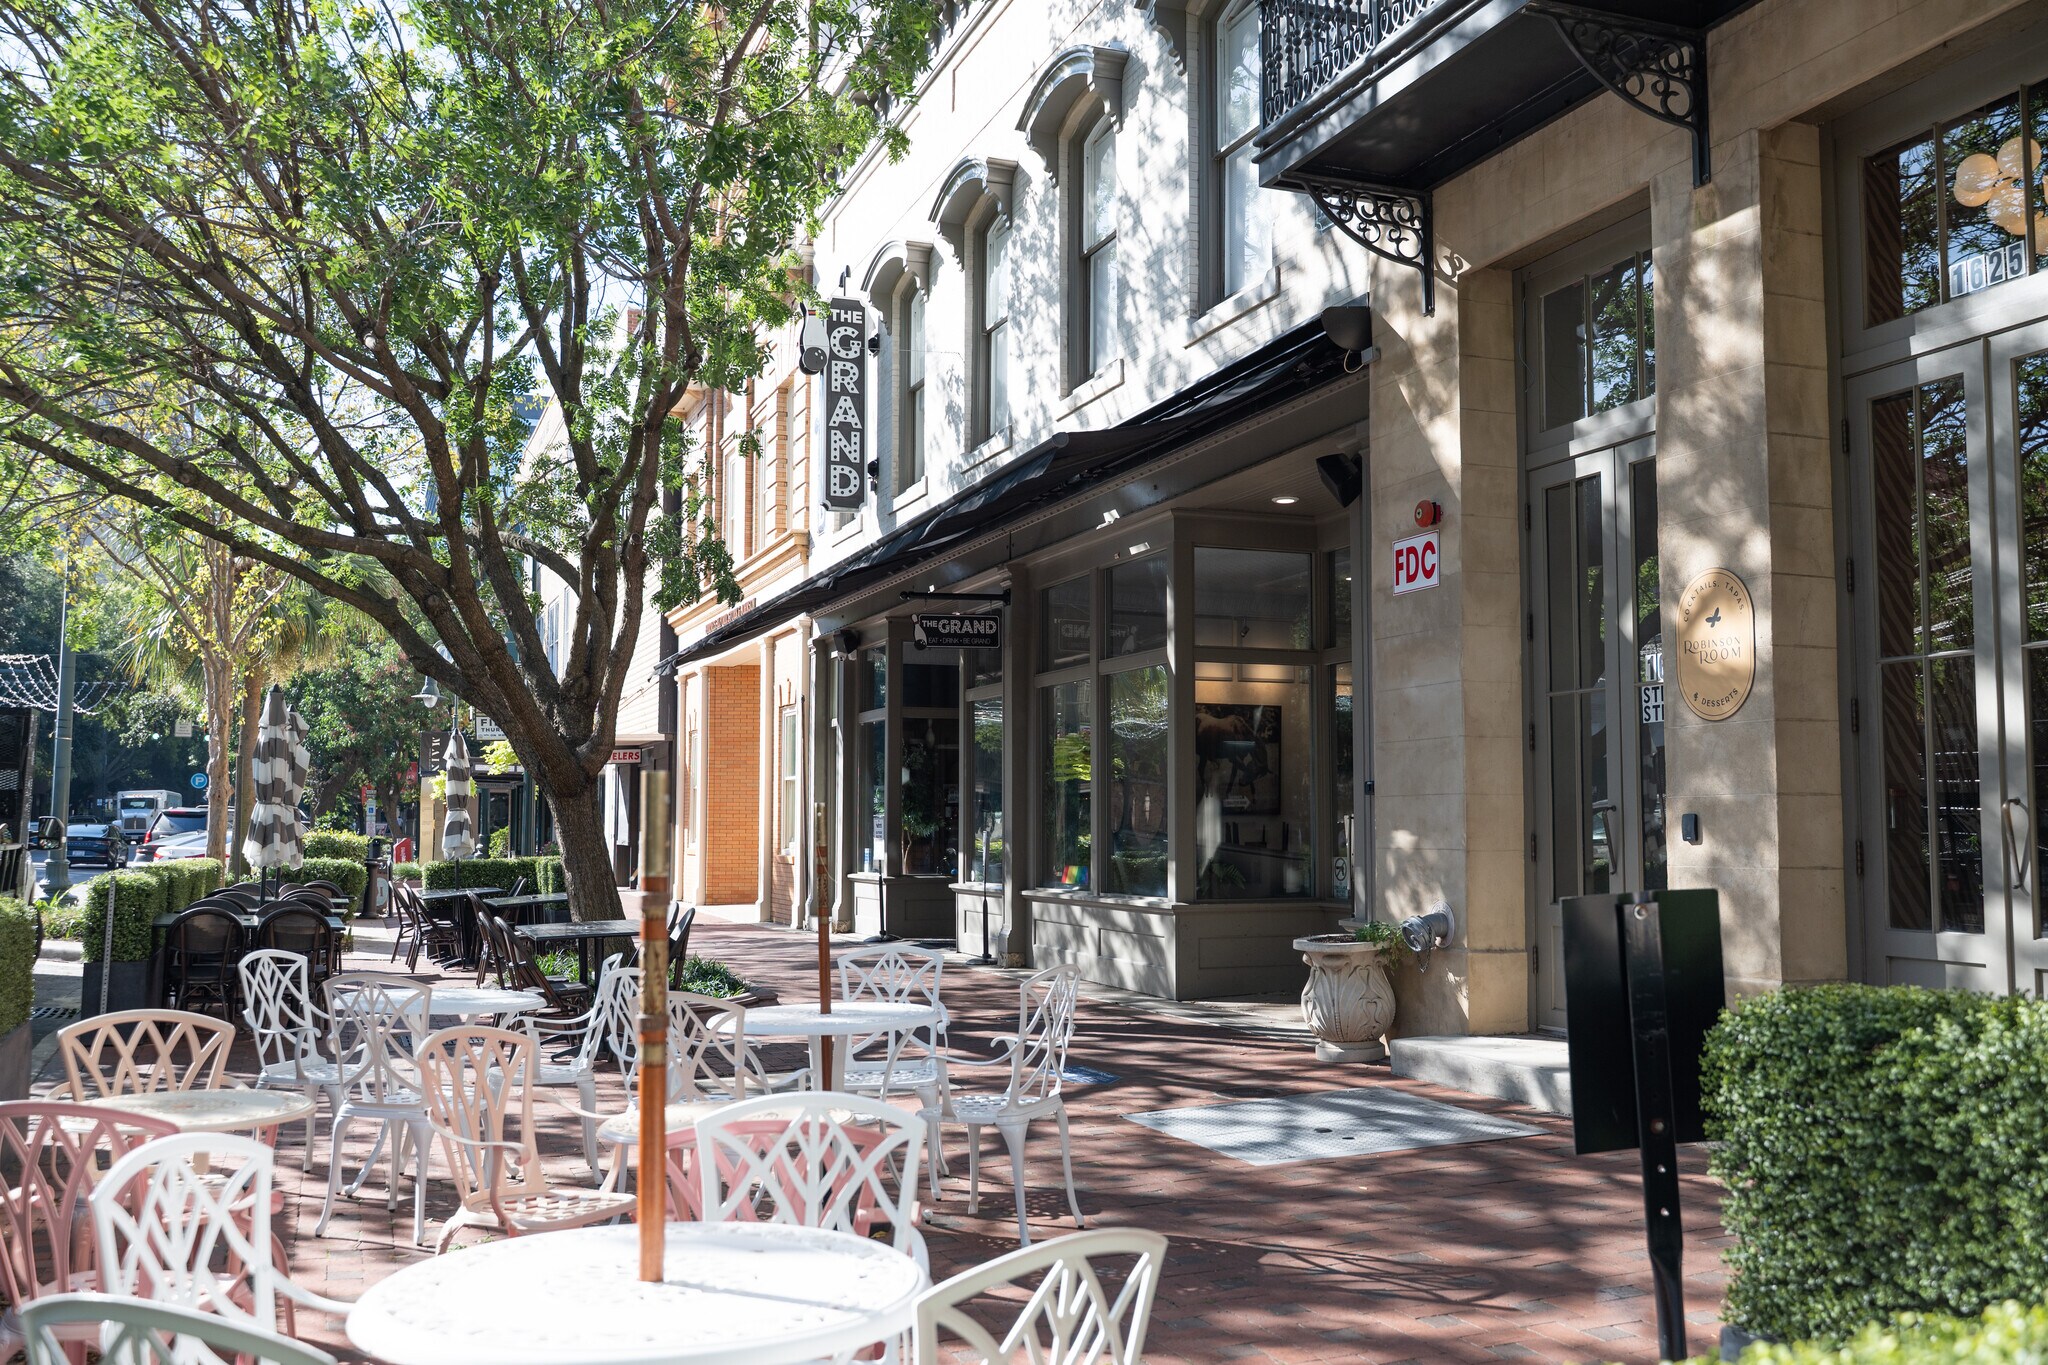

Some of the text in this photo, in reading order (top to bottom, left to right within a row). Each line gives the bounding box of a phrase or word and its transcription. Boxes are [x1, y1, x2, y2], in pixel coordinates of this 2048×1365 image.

[1952, 242, 2024, 295] 1625
[831, 308, 863, 324] THE
[828, 326, 863, 497] GRAND
[1395, 540, 1436, 587] FDC
[921, 619, 997, 634] THE GRAND
[962, 637, 971, 645] BE
[971, 637, 991, 645] GRAND
[1684, 636, 1741, 654] ROBINSON
[1700, 646, 1741, 664] ROOM
[1701, 687, 1739, 708] DESSERTS
[480, 718, 497, 727] FI
[610, 752, 640, 761] ELERS
[195, 776, 205, 786] P
